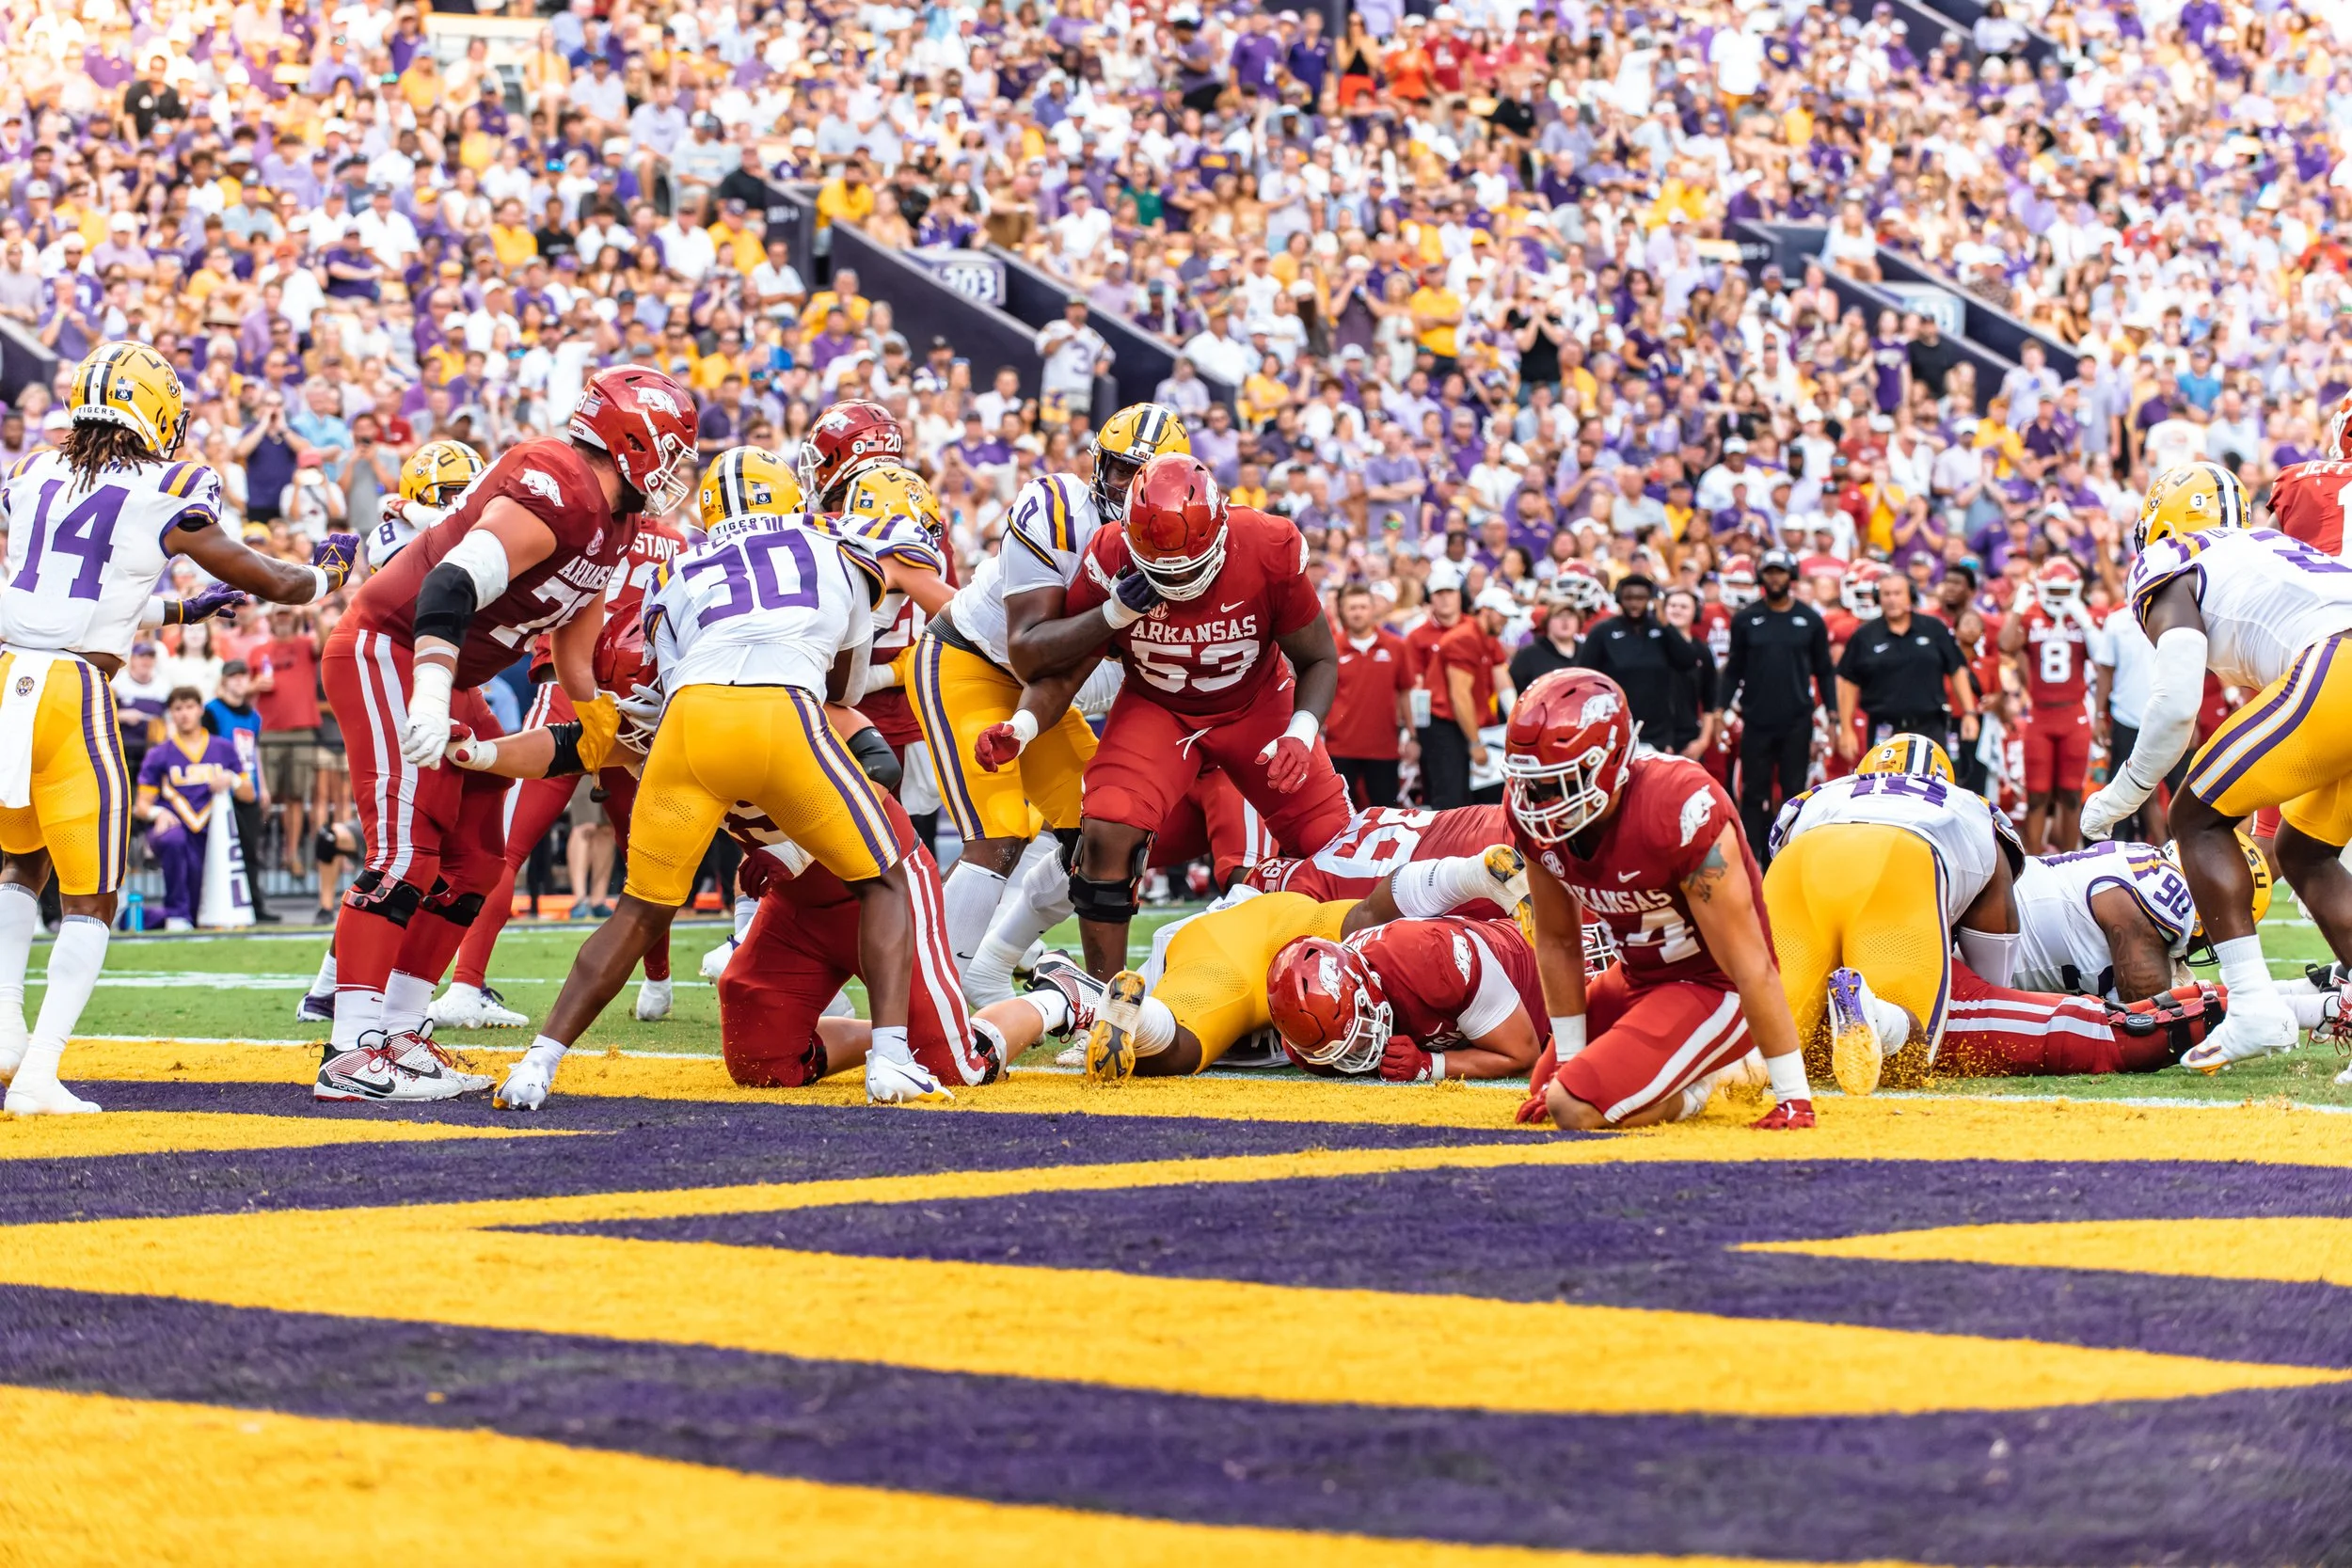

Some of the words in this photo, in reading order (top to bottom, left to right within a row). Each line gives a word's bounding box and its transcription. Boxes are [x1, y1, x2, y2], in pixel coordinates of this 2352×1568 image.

[78, 406, 115, 417] TIGERS
[884, 433, 902, 452] 20
[1132, 449, 1152, 460] LSU
[10, 479, 130, 601] 14
[379, 522, 396, 546] 8
[630, 531, 680, 562] STAVE
[558, 555, 614, 590] ARKANS
[681, 528, 819, 629] 30
[1131, 614, 1258, 643] ARKANSAS
[1131, 639, 1260, 693] 53
[2040, 641, 2072, 683] 8
[2244, 849, 2268, 889] SU
[1559, 880, 1673, 914] KANSAS
[2153, 873, 2193, 921] 90
